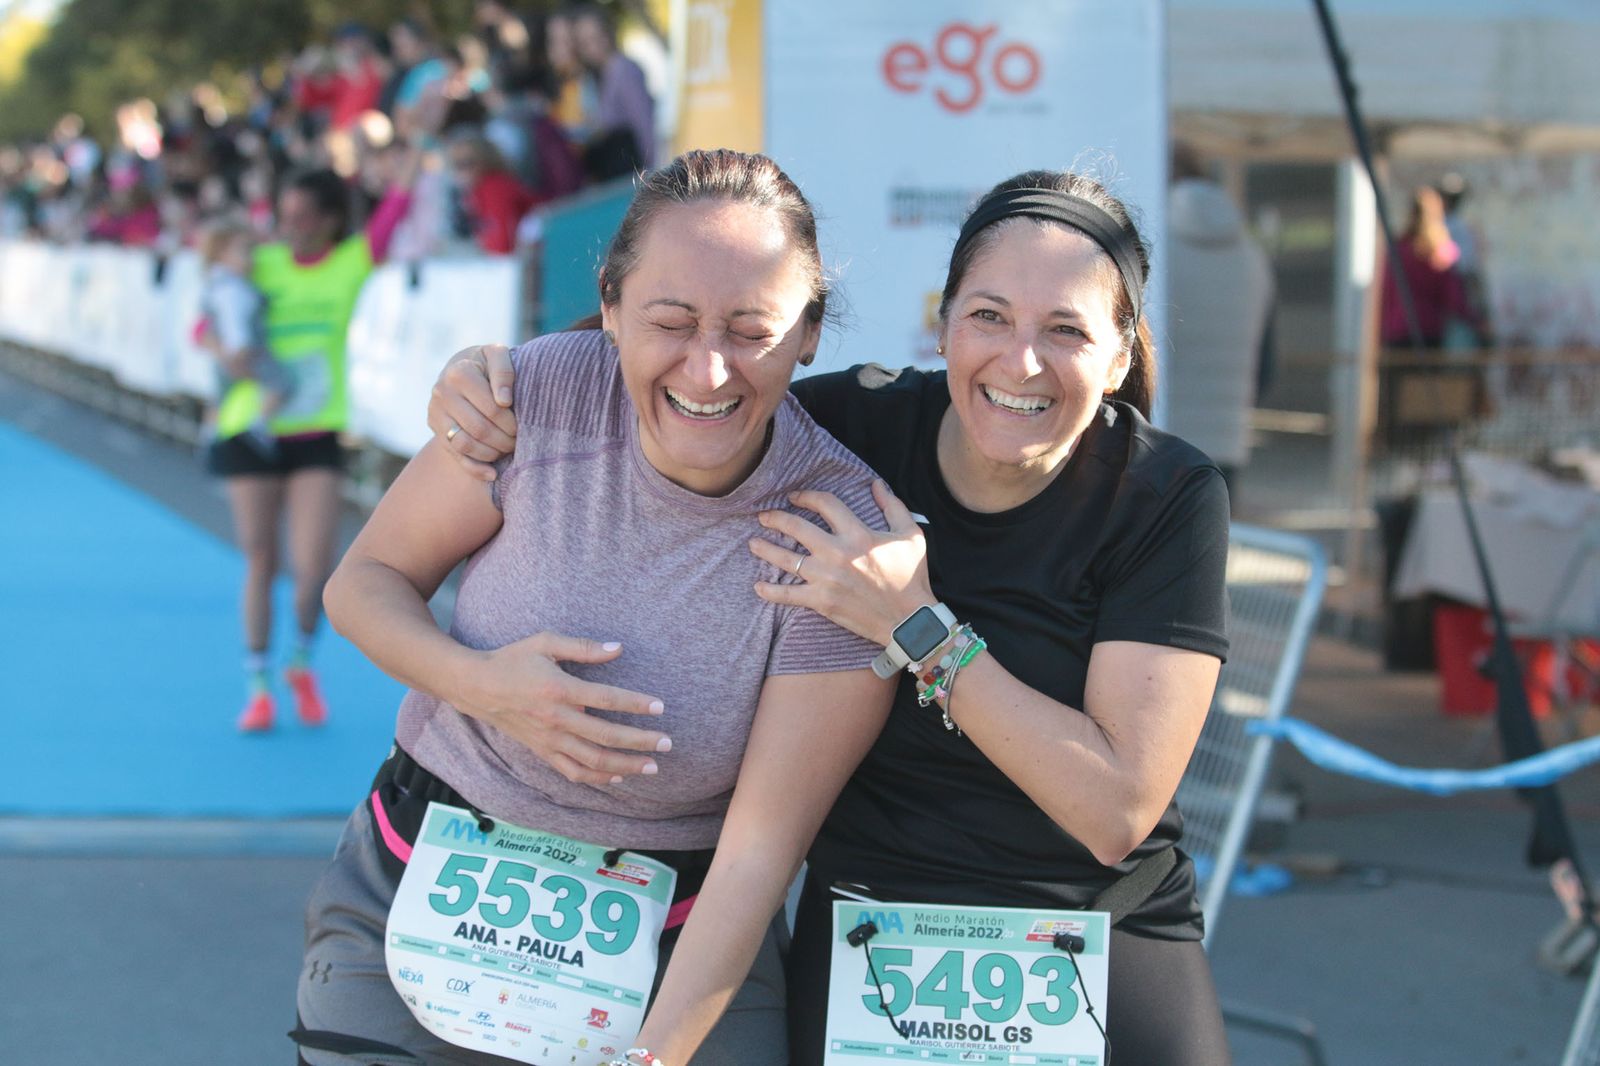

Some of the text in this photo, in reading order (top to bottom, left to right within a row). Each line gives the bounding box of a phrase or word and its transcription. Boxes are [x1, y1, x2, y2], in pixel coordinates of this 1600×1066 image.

[882, 21, 1042, 114] ego
[494, 839, 541, 854] Almería
[543, 845, 577, 864] 2022
[500, 829, 582, 854] Medio Maratón
[428, 853, 640, 956] 5539
[914, 913, 1005, 926] Medio Maratón
[914, 924, 965, 937] Almería
[967, 926, 1003, 939] 2022
[453, 921, 498, 947] ANA
[517, 935, 584, 968] PAULA
[472, 944, 487, 953] ANA
[399, 968, 425, 985] NEXA
[446, 978, 475, 993] CDX
[862, 947, 1079, 1026] 5493
[900, 1020, 1033, 1044] MARISOL GS
[910, 1039, 942, 1049] MARISOL
[989, 1044, 1020, 1052] SABIOTE
